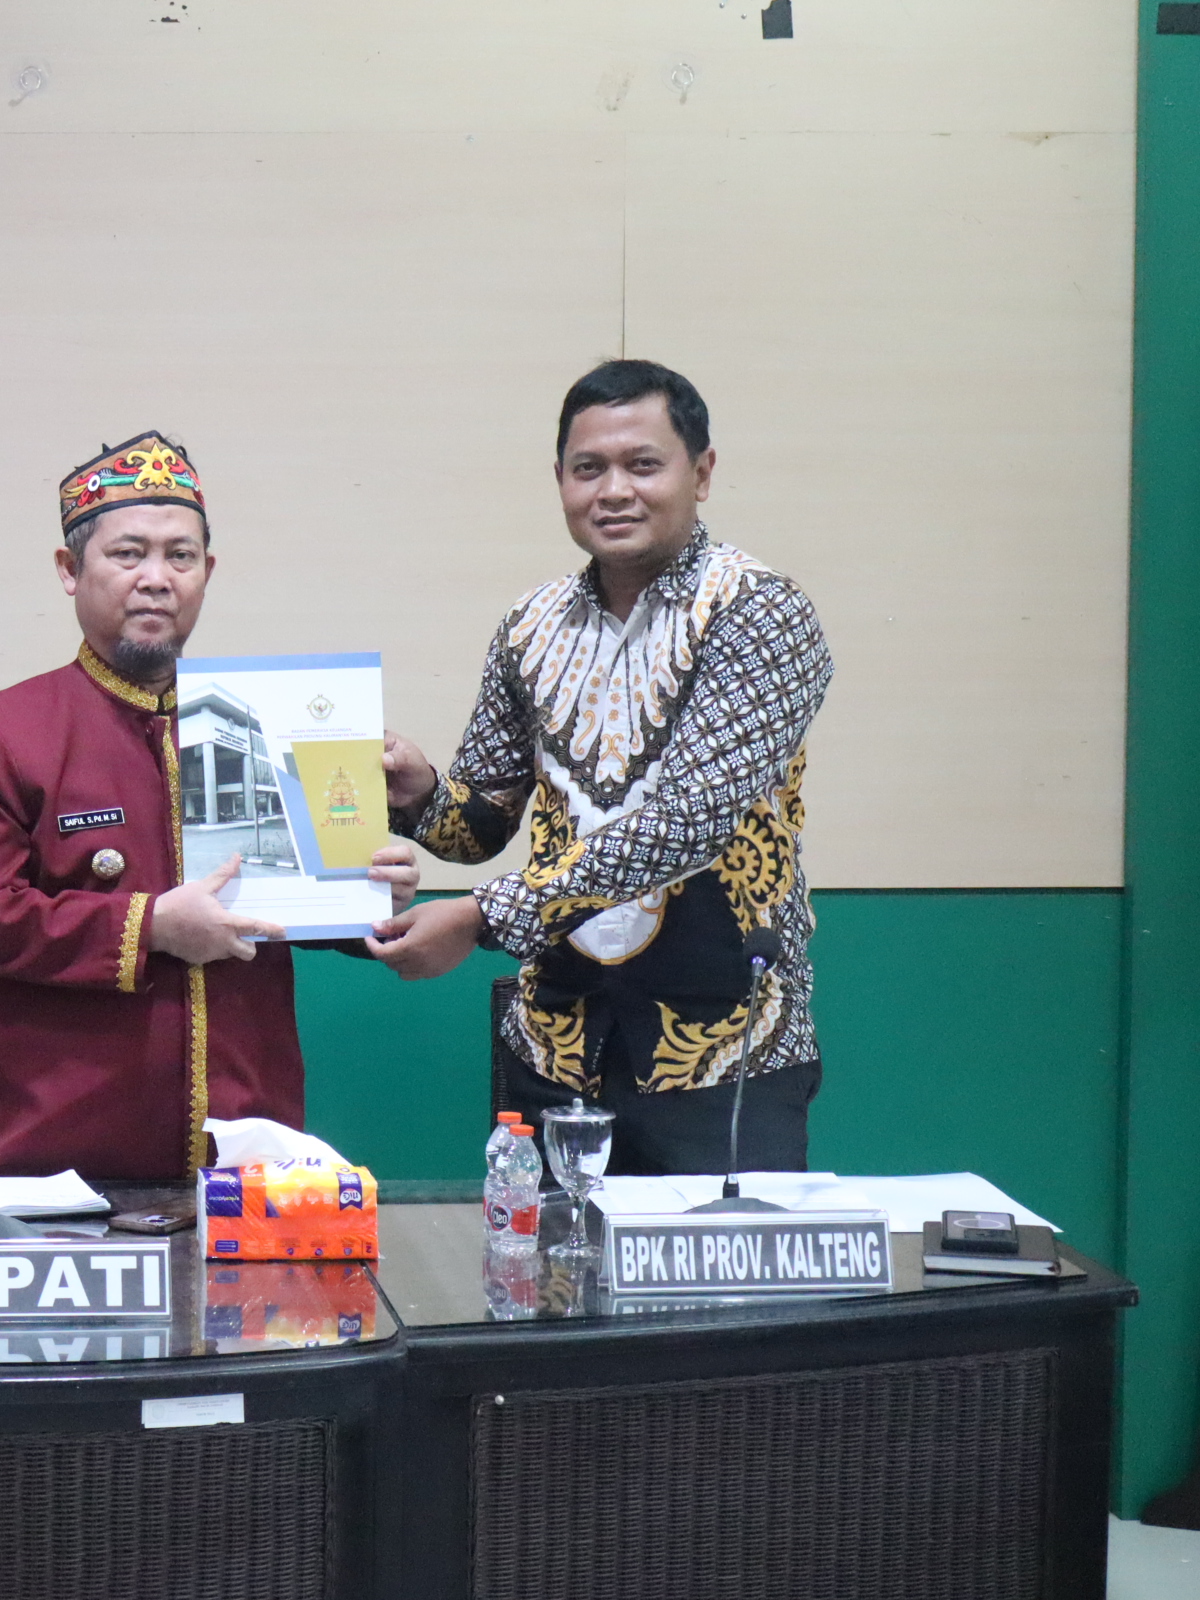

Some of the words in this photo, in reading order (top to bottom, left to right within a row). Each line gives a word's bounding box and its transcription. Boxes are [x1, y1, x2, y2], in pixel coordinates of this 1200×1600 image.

[64, 818, 86, 826] SAIFUL
[493, 1211, 508, 1225] Cleo
[621, 1236, 668, 1282] BPK
[673, 1235, 697, 1281] RI
[702, 1233, 770, 1281] PROV.
[775, 1231, 881, 1279] KALTENG
